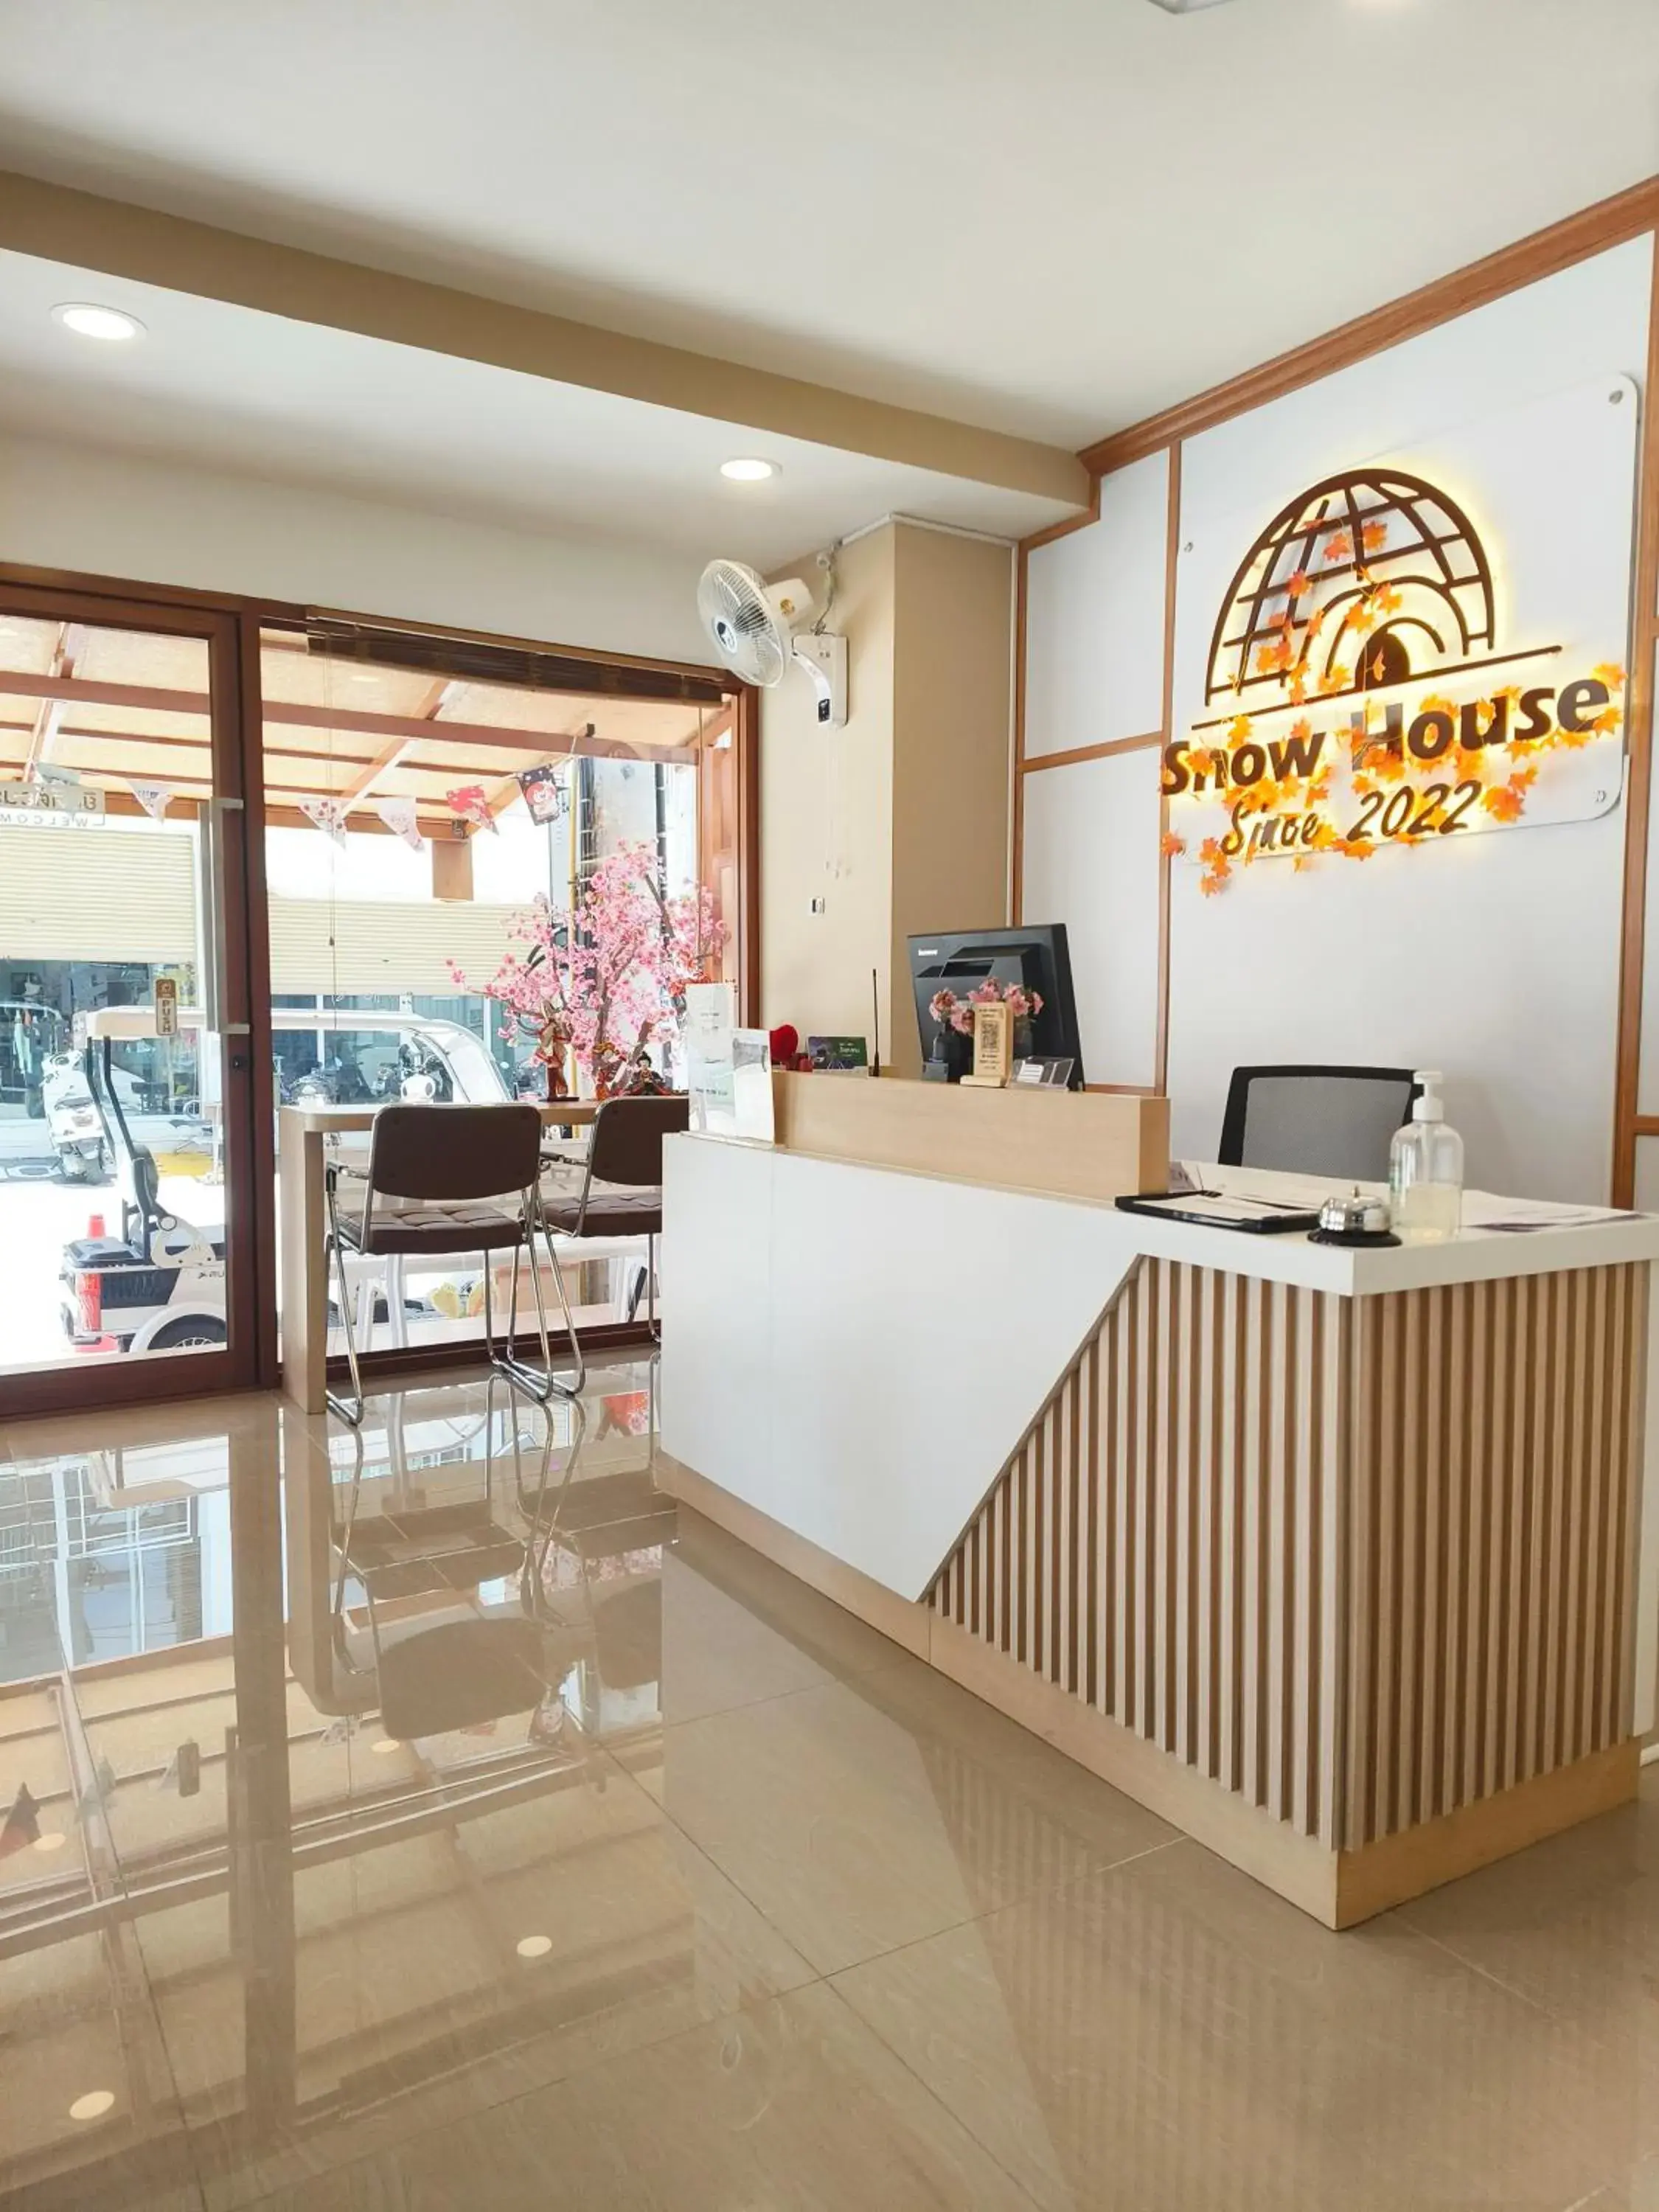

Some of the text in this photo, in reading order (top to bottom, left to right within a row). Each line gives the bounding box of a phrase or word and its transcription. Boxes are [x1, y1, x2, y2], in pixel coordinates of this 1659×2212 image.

[1161, 678, 1610, 796] Snow House
[1220, 779, 1482, 856] Since 2022
[161, 999, 171, 1033] PUSH
